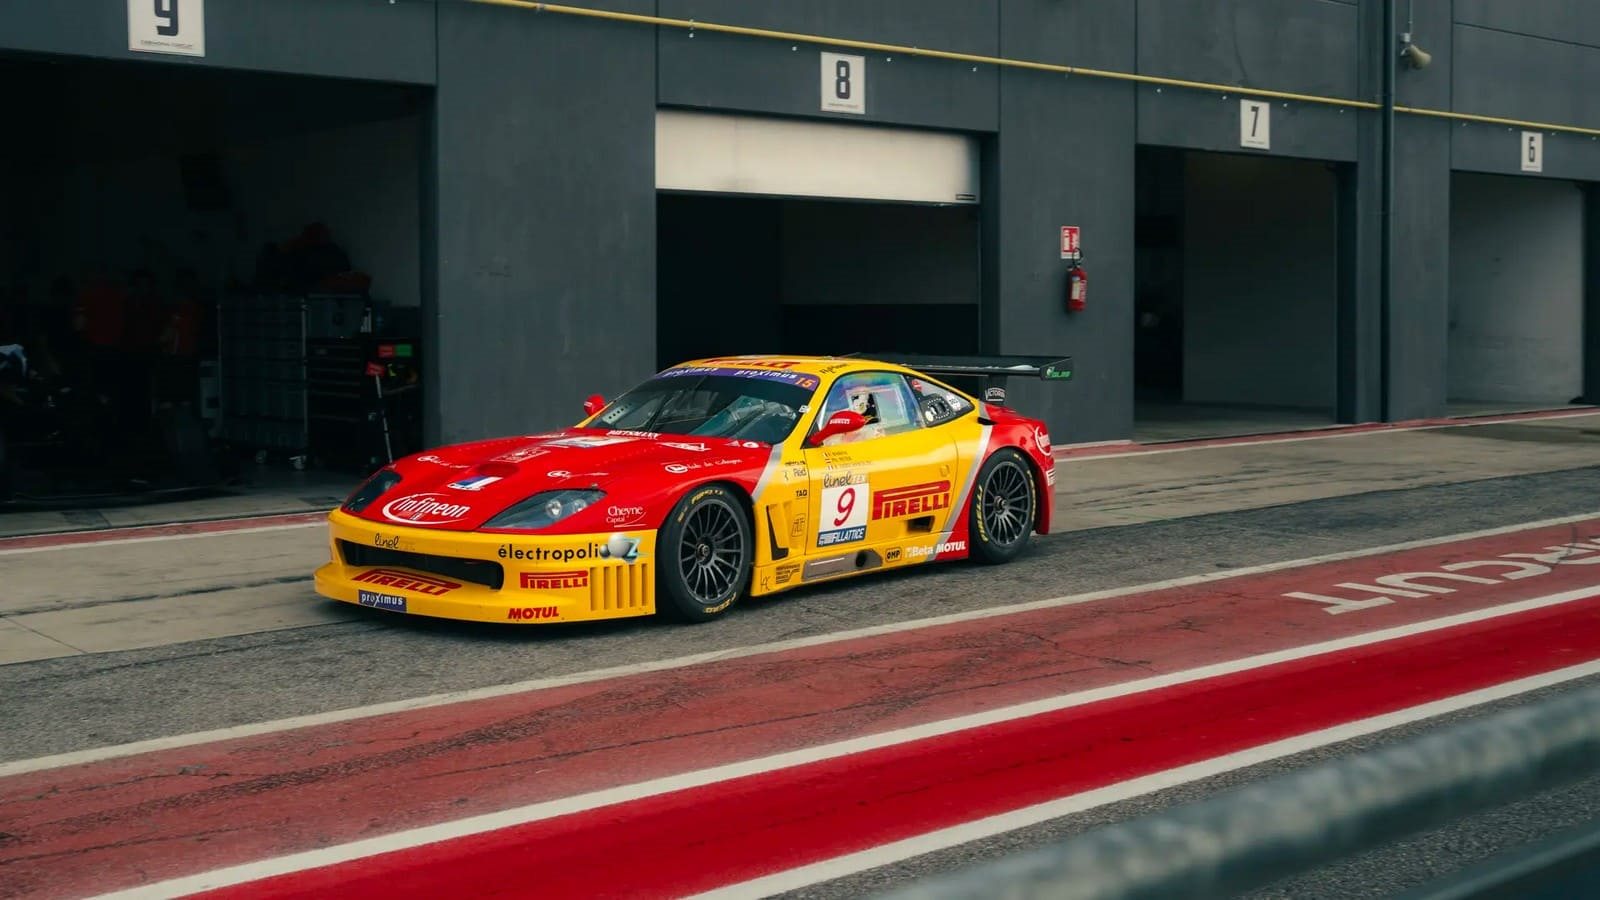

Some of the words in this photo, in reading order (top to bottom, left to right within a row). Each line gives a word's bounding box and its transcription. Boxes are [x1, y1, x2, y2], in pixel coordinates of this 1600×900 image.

[154, 0, 179, 36] 9
[836, 60, 851, 99] 8
[1251, 106, 1260, 137] 7
[1529, 136, 1536, 162] 6
[734, 369, 798, 380] proximus
[795, 377, 816, 389] 15
[823, 471, 852, 488] linel
[393, 497, 471, 519] Infineon
[834, 487, 856, 527] 9
[872, 480, 951, 521] PIRELLI
[607, 505, 644, 519] Cheyne
[375, 532, 400, 550] linel
[935, 540, 967, 554] MOTUL
[498, 543, 599, 563] électropoli
[886, 551, 901, 561] OMP
[912, 545, 934, 558] Beta
[351, 568, 462, 596] PIRELLI
[520, 570, 589, 590] PIRELLI
[1281, 536, 1600, 615] RCUIT
[361, 592, 404, 607] proximus
[508, 606, 560, 620] MOTUL
